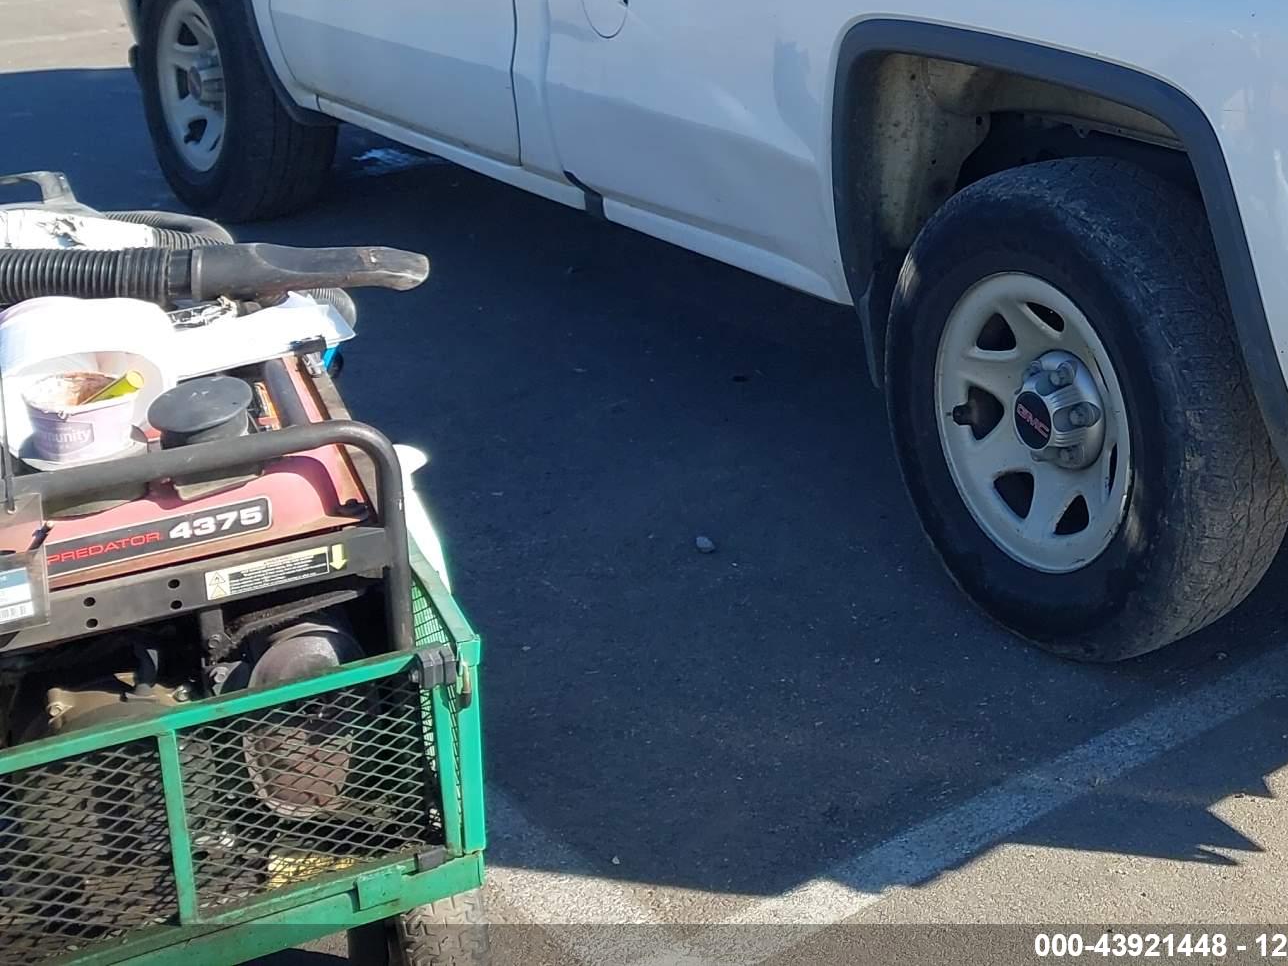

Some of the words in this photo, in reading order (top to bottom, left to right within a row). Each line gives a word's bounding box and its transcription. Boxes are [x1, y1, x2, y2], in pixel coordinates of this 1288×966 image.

[1017, 403, 1050, 439] GMC
[46, 531, 161, 566] PREDATOR
[168, 506, 263, 540] 4375
